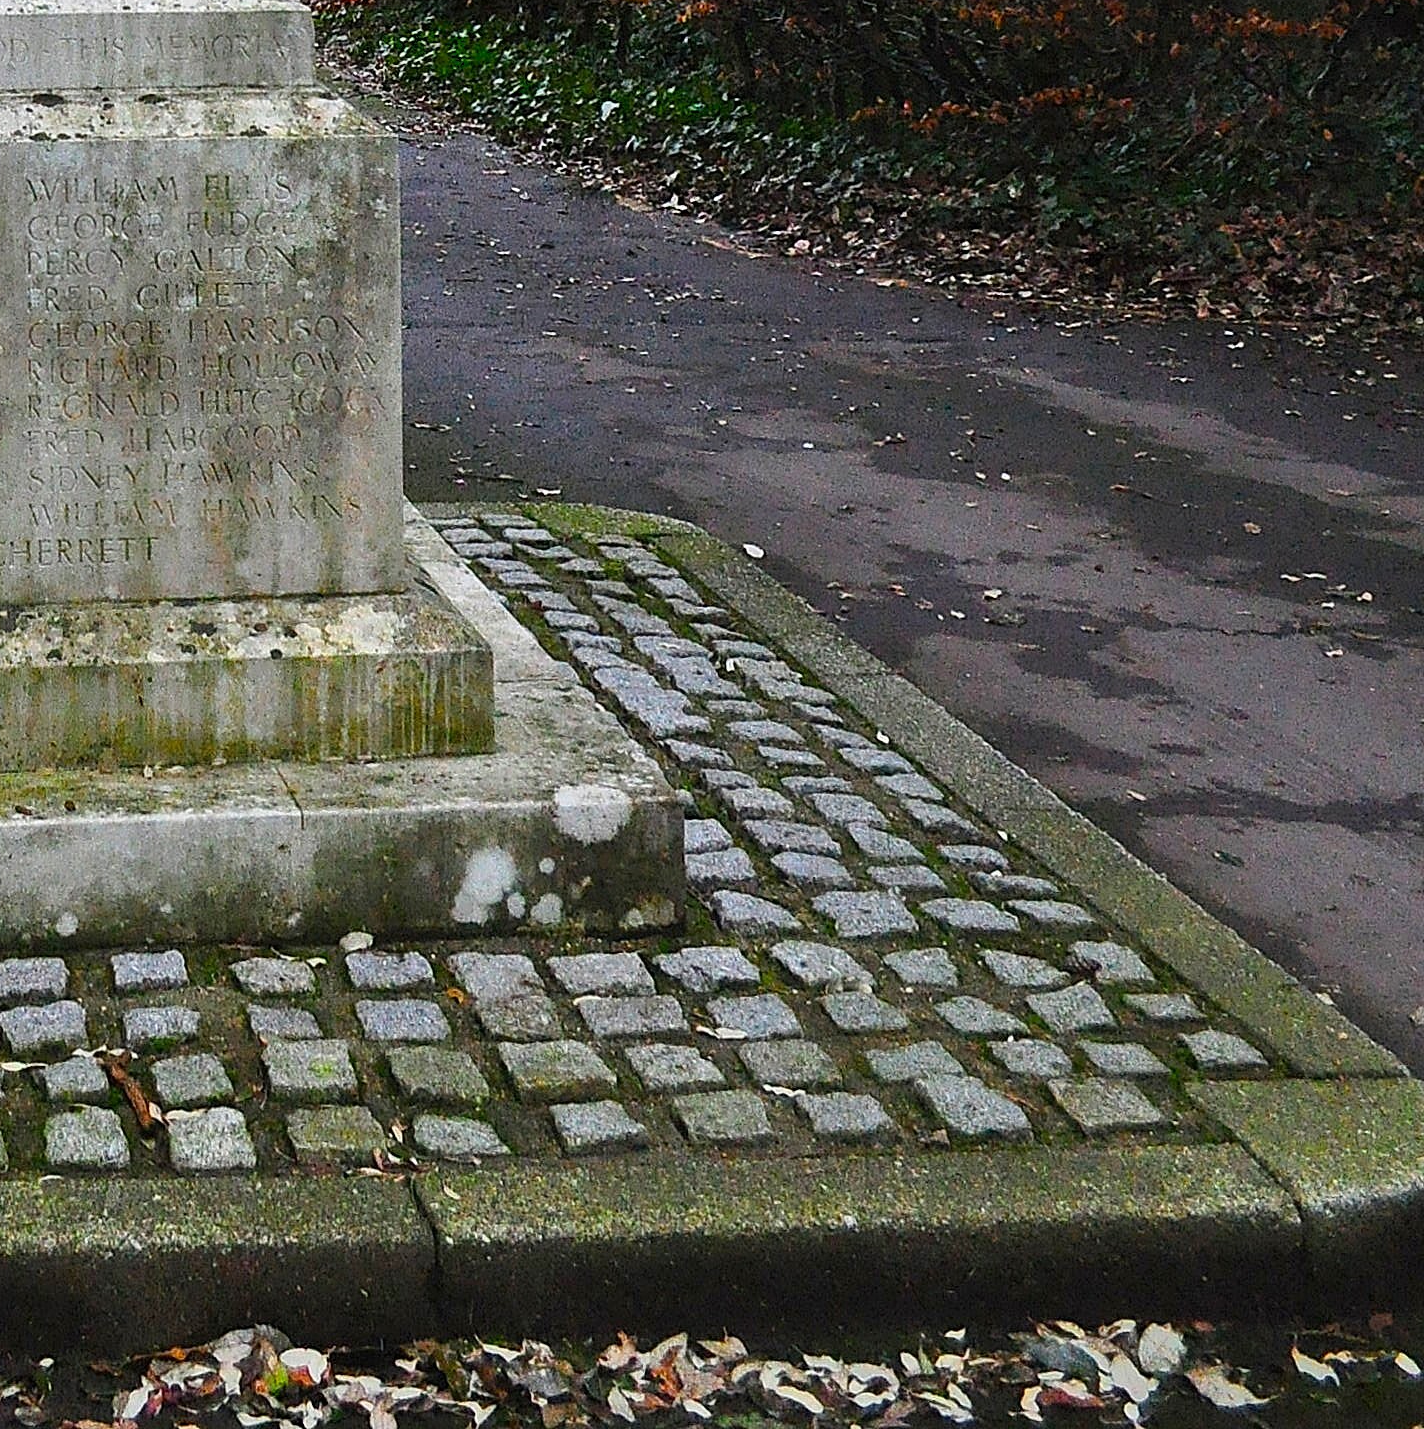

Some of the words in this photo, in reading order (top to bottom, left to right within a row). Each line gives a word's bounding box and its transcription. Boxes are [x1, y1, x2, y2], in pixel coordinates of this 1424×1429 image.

[60, 36, 126, 61] THIS
[25, 175, 180, 204] WILLIAM
[203, 173, 294, 202] ELLIS
[26, 212, 166, 241] GEORGE
[185, 208, 298, 238] FUDGE
[25, 247, 128, 276] PERCY
[153, 244, 300, 273] GALTON
[26, 285, 109, 313] FRED
[136, 280, 277, 310] GILLETT
[27, 319, 165, 349] GEORGE
[188, 313, 367, 344] HARRISON
[26, 354, 178, 385] RICHARD
[200, 349, 382, 380] HOLLOWAY
[26, 390, 181, 421] REGINALD
[26, 427, 106, 455] FRED
[123, 423, 303, 454] HABGOOD
[28, 463, 145, 492] SIDNEY
[27, 498, 178, 527] WILLIAM
[202, 493, 363, 523] HAWKINS
